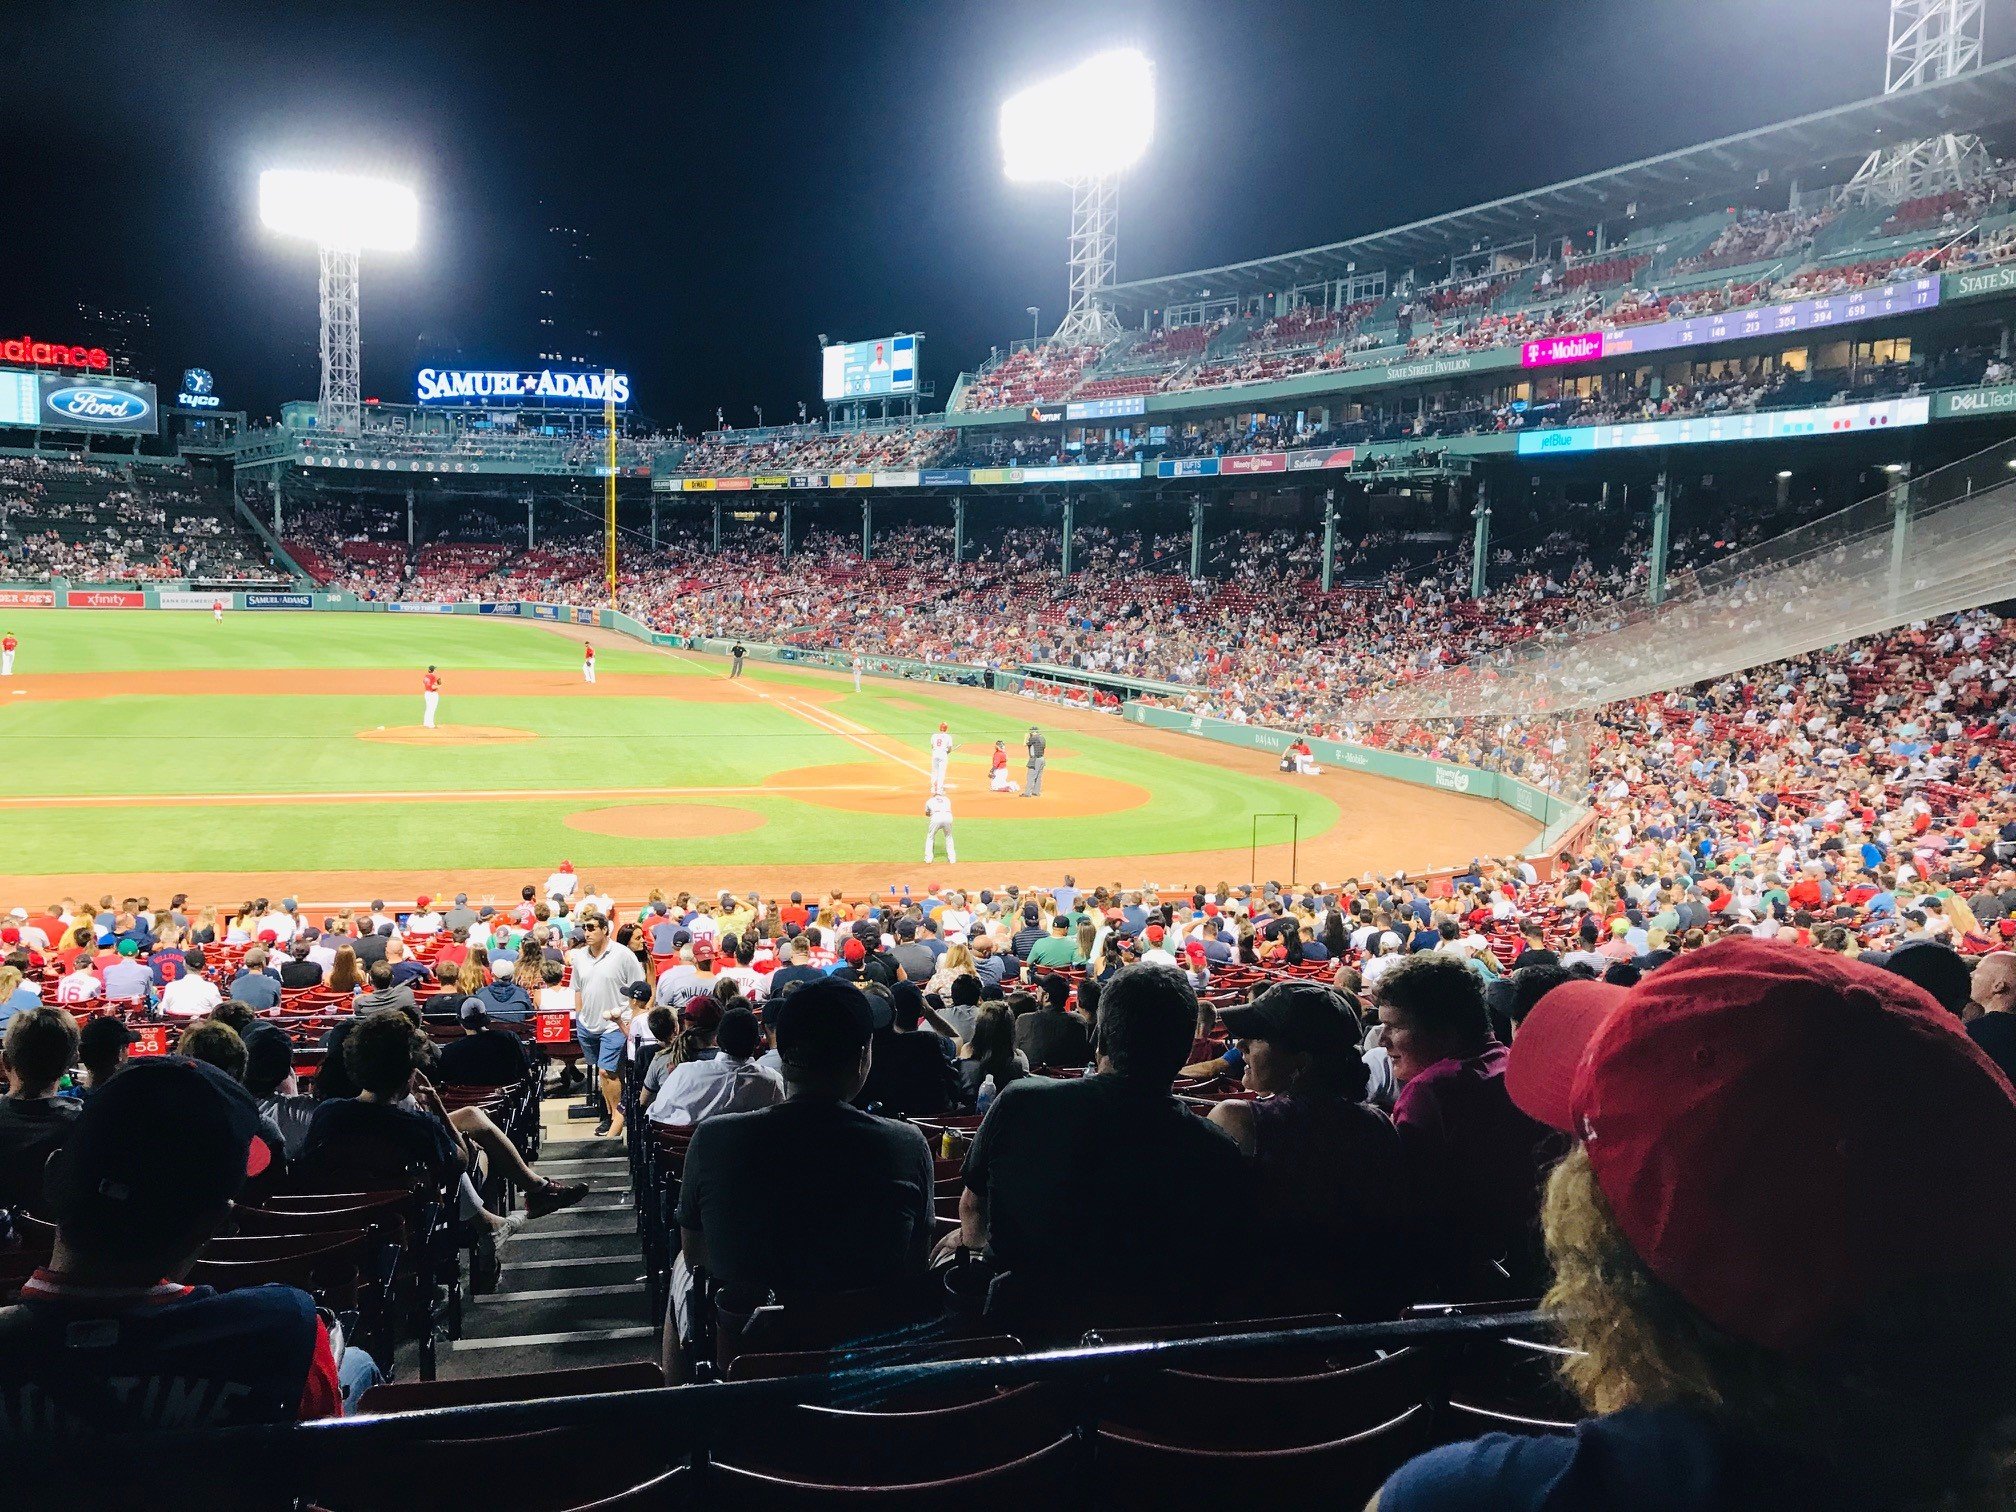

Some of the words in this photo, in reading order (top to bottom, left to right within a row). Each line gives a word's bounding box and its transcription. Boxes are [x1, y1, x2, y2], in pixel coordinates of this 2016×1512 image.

[1959, 274, 1998, 294] STATE
[1745, 311, 1758, 319] AVG
[1814, 300, 1829, 309] SLG
[1849, 293, 1862, 302] OPS
[1917, 281, 1930, 290] RBI
[1682, 332, 1693, 341] 35
[1813, 310, 1832, 323] .394
[1845, 304, 1866, 317] .698
[1885, 300, 1891, 311] 6
[1917, 293, 1927, 305] 17
[1386, 367, 1407, 380] STATE
[1408, 364, 1433, 376] STREET
[1434, 359, 1470, 373] PAVILION
[417, 367, 526, 400] SAMUEL
[535, 368, 631, 404] ADAMS
[68, 389, 130, 418] Ford
[179, 392, 220, 407] tyco
[1951, 393, 1988, 411] DELL
[1541, 433, 1572, 450] jetBlue
[1182, 460, 1202, 470] TUFTS
[1233, 459, 1251, 470] Ninety
[1260, 458, 1273, 467] Nine
[21, 594, 52, 604] JOE'S
[87, 593, 125, 606] xfinity
[248, 595, 280, 605] SAMUEL
[282, 595, 310, 605] ADAMS
[1436, 766, 1455, 780] Ninety
[1435, 774, 1454, 788] Nine
[161, 961, 176, 982] 9
[736, 977, 755, 988] RTIZ
[61, 986, 81, 1002] 16
[746, 989, 757, 1001] 4
[542, 1027, 564, 1038] 57
[134, 1041, 159, 1053] 58
